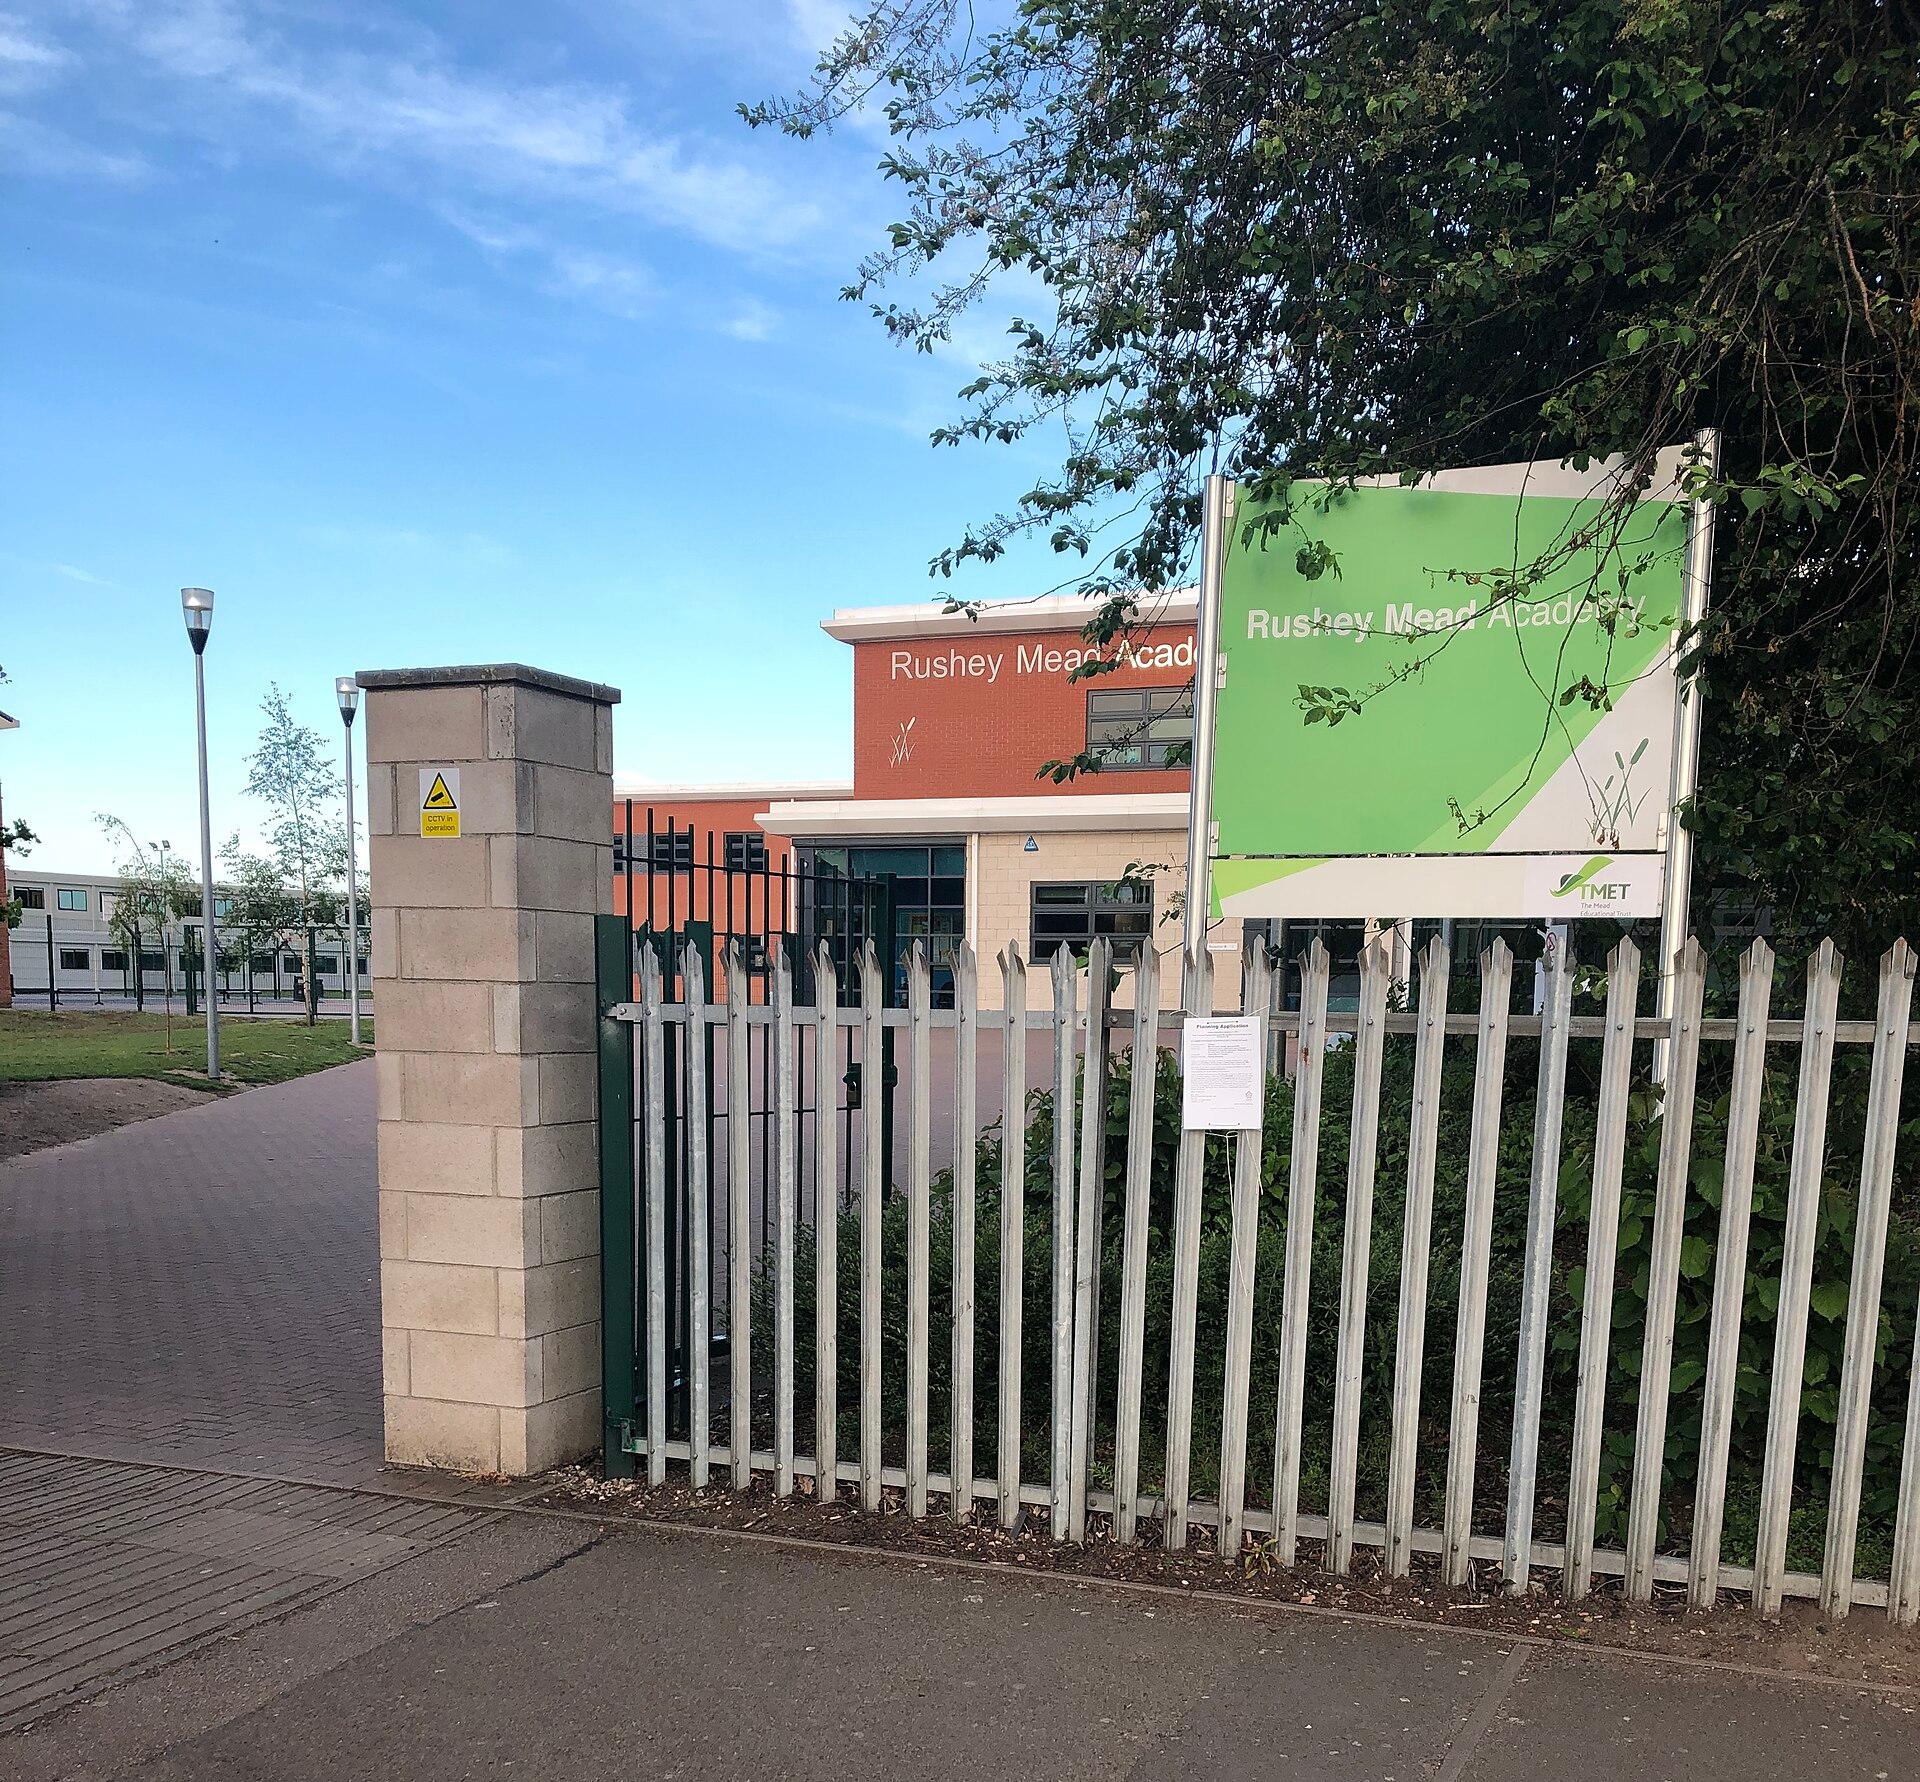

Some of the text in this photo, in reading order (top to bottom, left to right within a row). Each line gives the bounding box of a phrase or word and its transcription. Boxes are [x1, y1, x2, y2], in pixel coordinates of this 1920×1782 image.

[1247, 607, 1374, 643] Rushey
[1385, 599, 1477, 634] Mead
[891, 648, 1004, 684] Rushey
[1114, 635, 1198, 669] Acad
[1580, 883, 1631, 899] TMET
